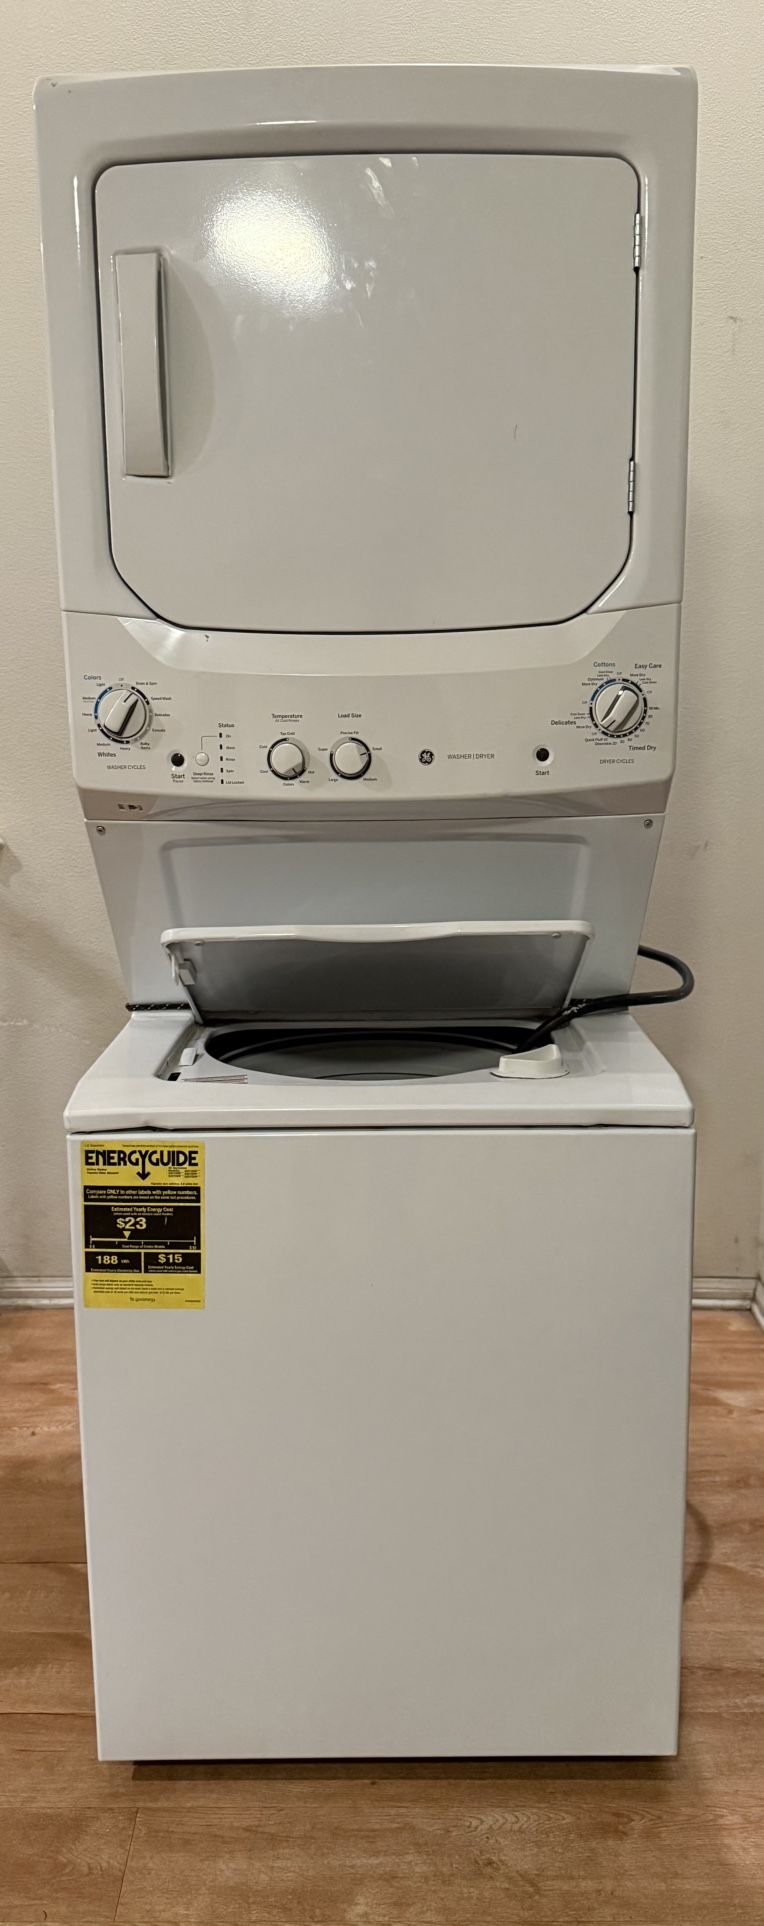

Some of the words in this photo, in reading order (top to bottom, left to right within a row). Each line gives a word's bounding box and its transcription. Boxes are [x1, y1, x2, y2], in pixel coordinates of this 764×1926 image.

[84, 1149, 199, 1168] ENERGYGUIDE
[116, 1217, 147, 1230] $23
[96, 1255, 118, 1264] 188
[158, 1254, 182, 1263] $15
